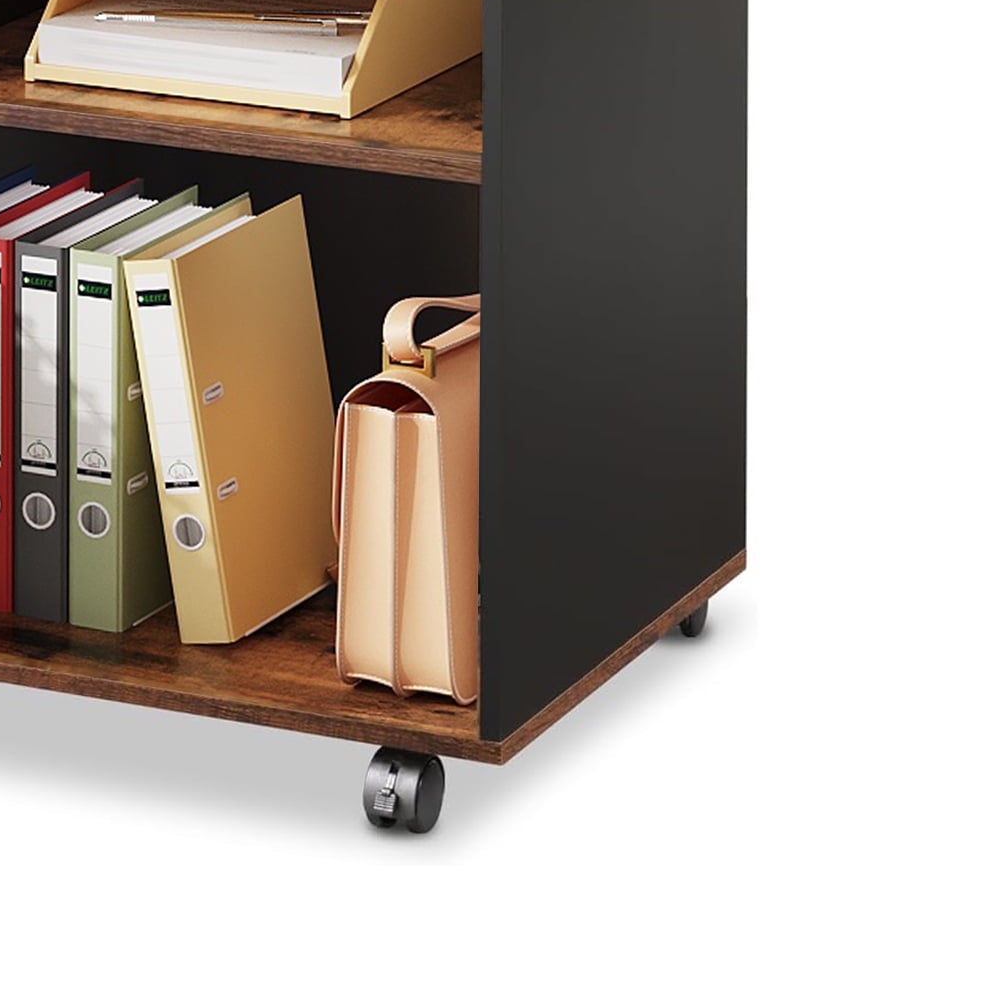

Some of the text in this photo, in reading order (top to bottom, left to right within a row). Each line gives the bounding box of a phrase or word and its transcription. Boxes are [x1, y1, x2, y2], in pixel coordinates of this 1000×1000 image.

[30, 276, 54, 288] LEITZ
[85, 285, 110, 296] LEITZ
[144, 293, 168, 303] LEITZ
